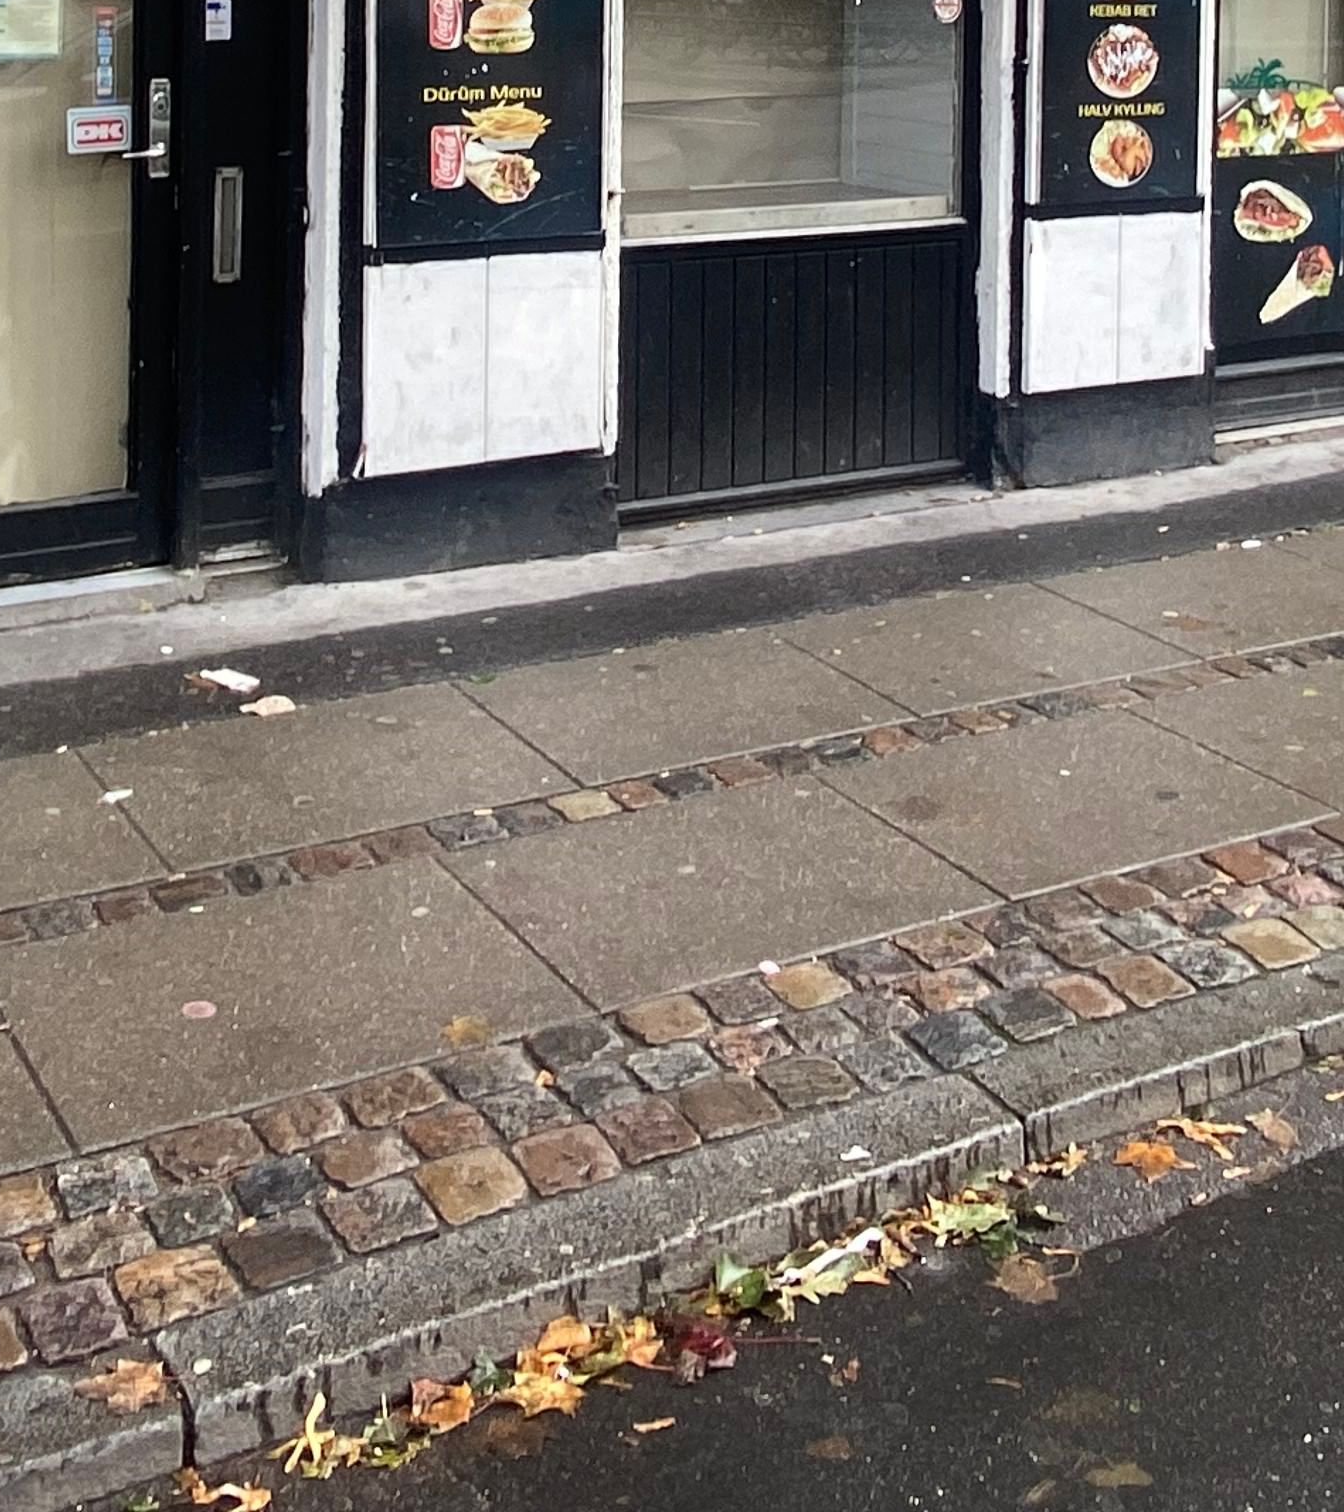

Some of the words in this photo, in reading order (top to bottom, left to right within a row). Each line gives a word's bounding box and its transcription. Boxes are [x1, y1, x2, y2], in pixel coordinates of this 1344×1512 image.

[1089, 3, 1132, 18] KEBAB
[1134, 4, 1158, 18] RET
[490, 84, 543, 101] Menu
[1078, 103, 1112, 118] HALV
[1114, 102, 1166, 118] KYLLING
[76, 123, 124, 140] DK
